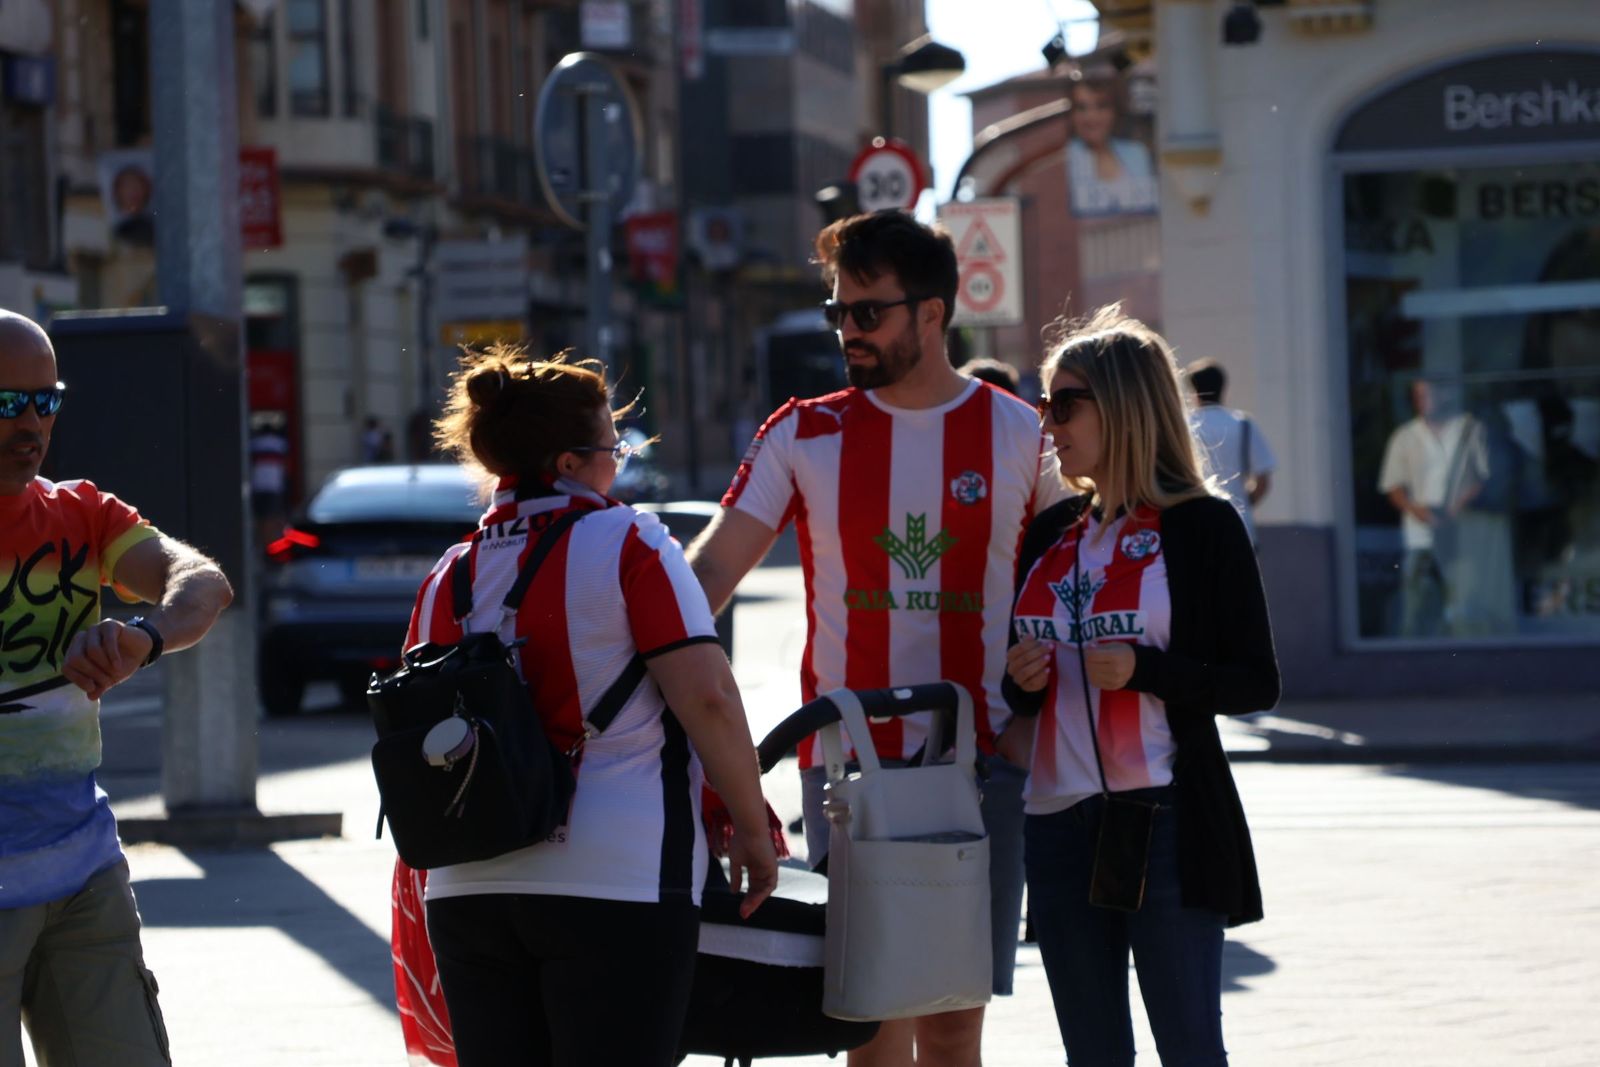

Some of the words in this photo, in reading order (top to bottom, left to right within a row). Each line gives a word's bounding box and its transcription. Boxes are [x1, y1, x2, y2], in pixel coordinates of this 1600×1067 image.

[866, 168, 909, 200] 30
[843, 589, 899, 610] CAJA
[906, 591, 985, 612] RURAL
[1014, 617, 1061, 642] AJA
